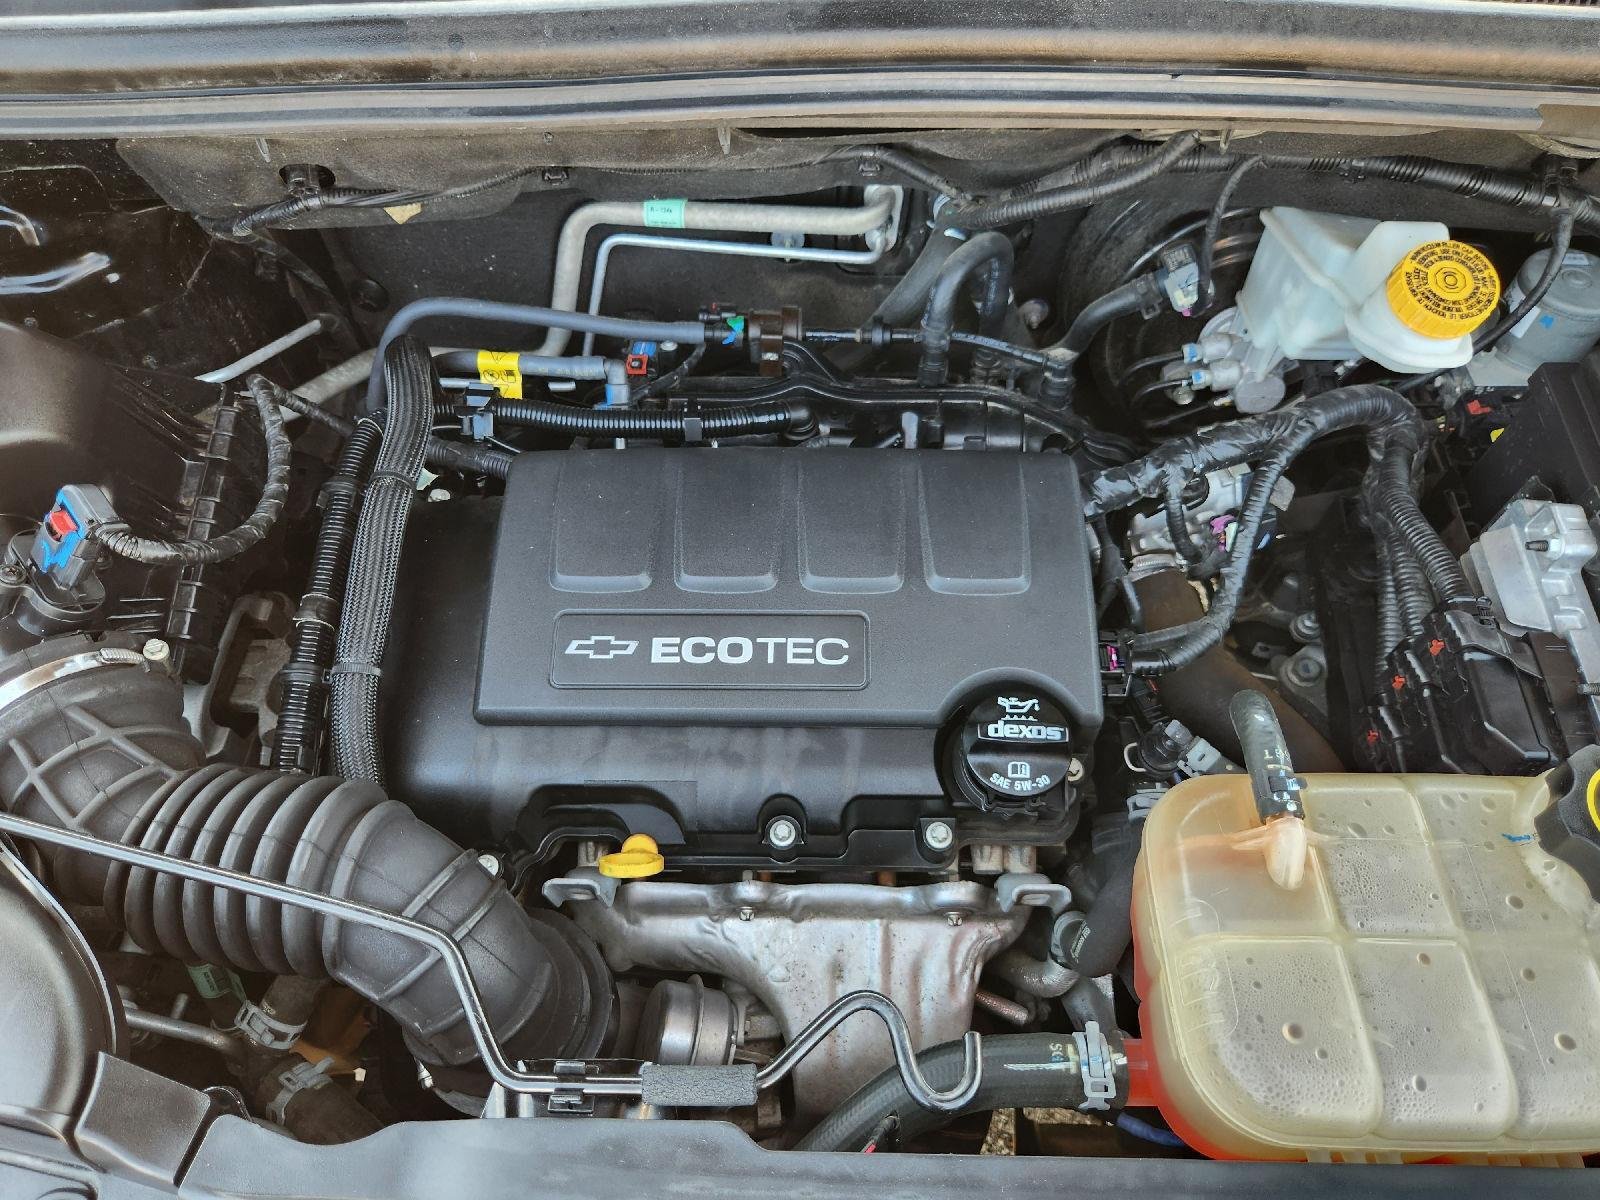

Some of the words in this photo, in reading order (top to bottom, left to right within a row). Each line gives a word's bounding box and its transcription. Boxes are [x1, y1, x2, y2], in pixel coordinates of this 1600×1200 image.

[650, 636, 849, 665] ECOTEC
[987, 720, 1065, 740] dexos
[989, 772, 1012, 789] SAE
[1013, 774, 1051, 791] 5W-30
